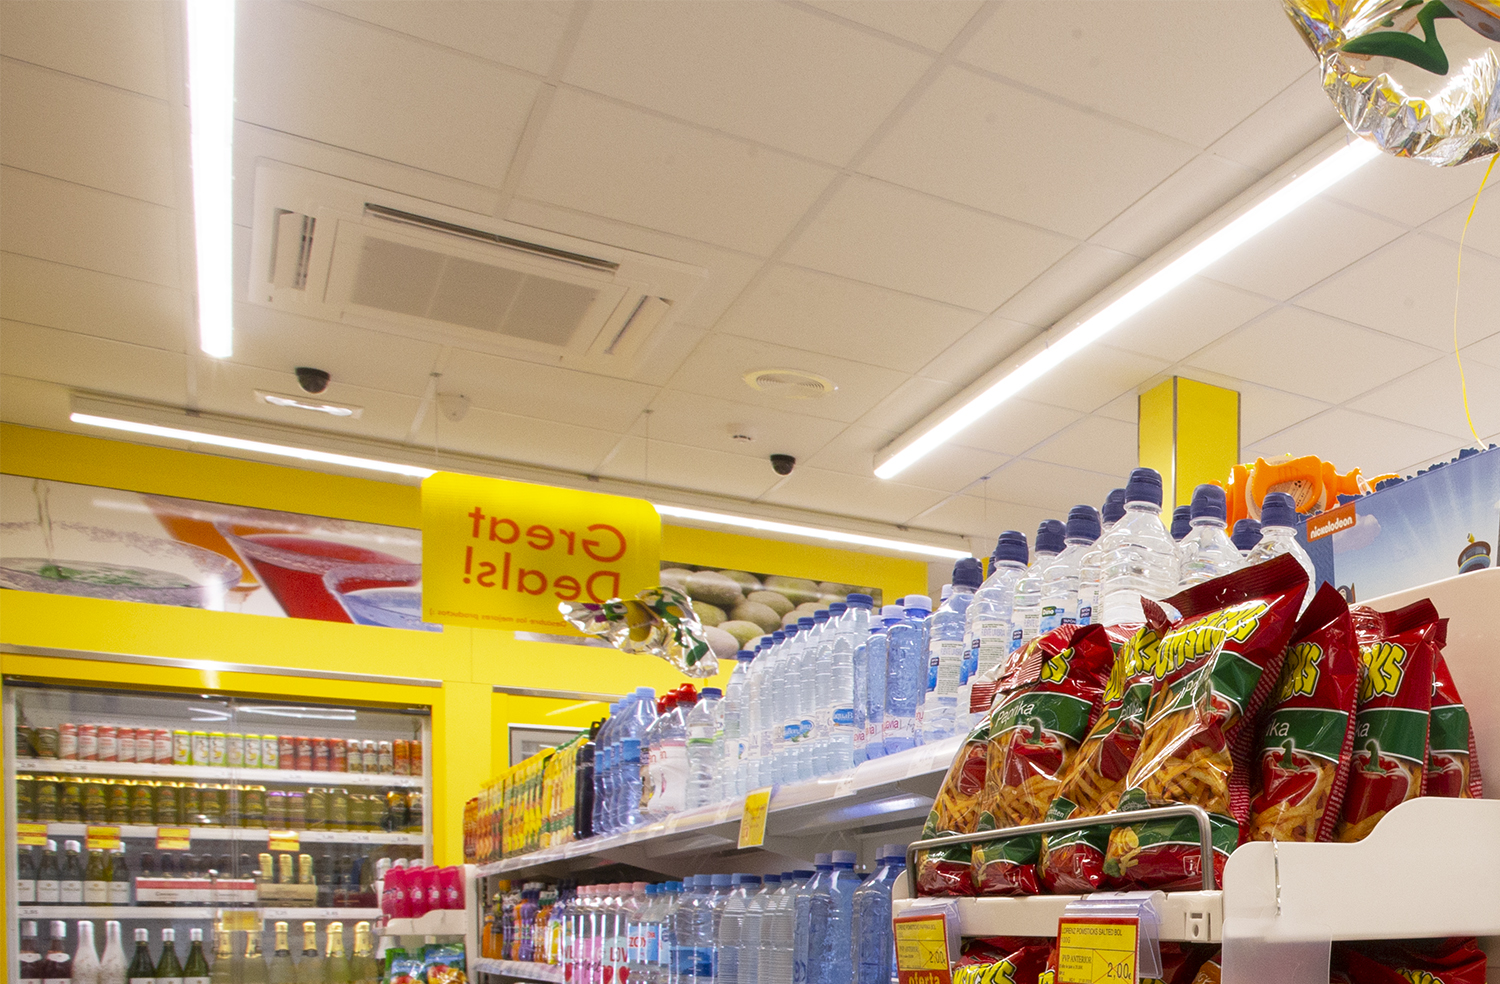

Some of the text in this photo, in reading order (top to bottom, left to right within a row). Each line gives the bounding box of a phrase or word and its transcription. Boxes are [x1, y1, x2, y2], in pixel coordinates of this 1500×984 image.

[1310, 516, 1353, 539] nickelodeon
[995, 701, 1034, 727] Paprika
[1070, 955, 1092, 963] ANTERIOR
